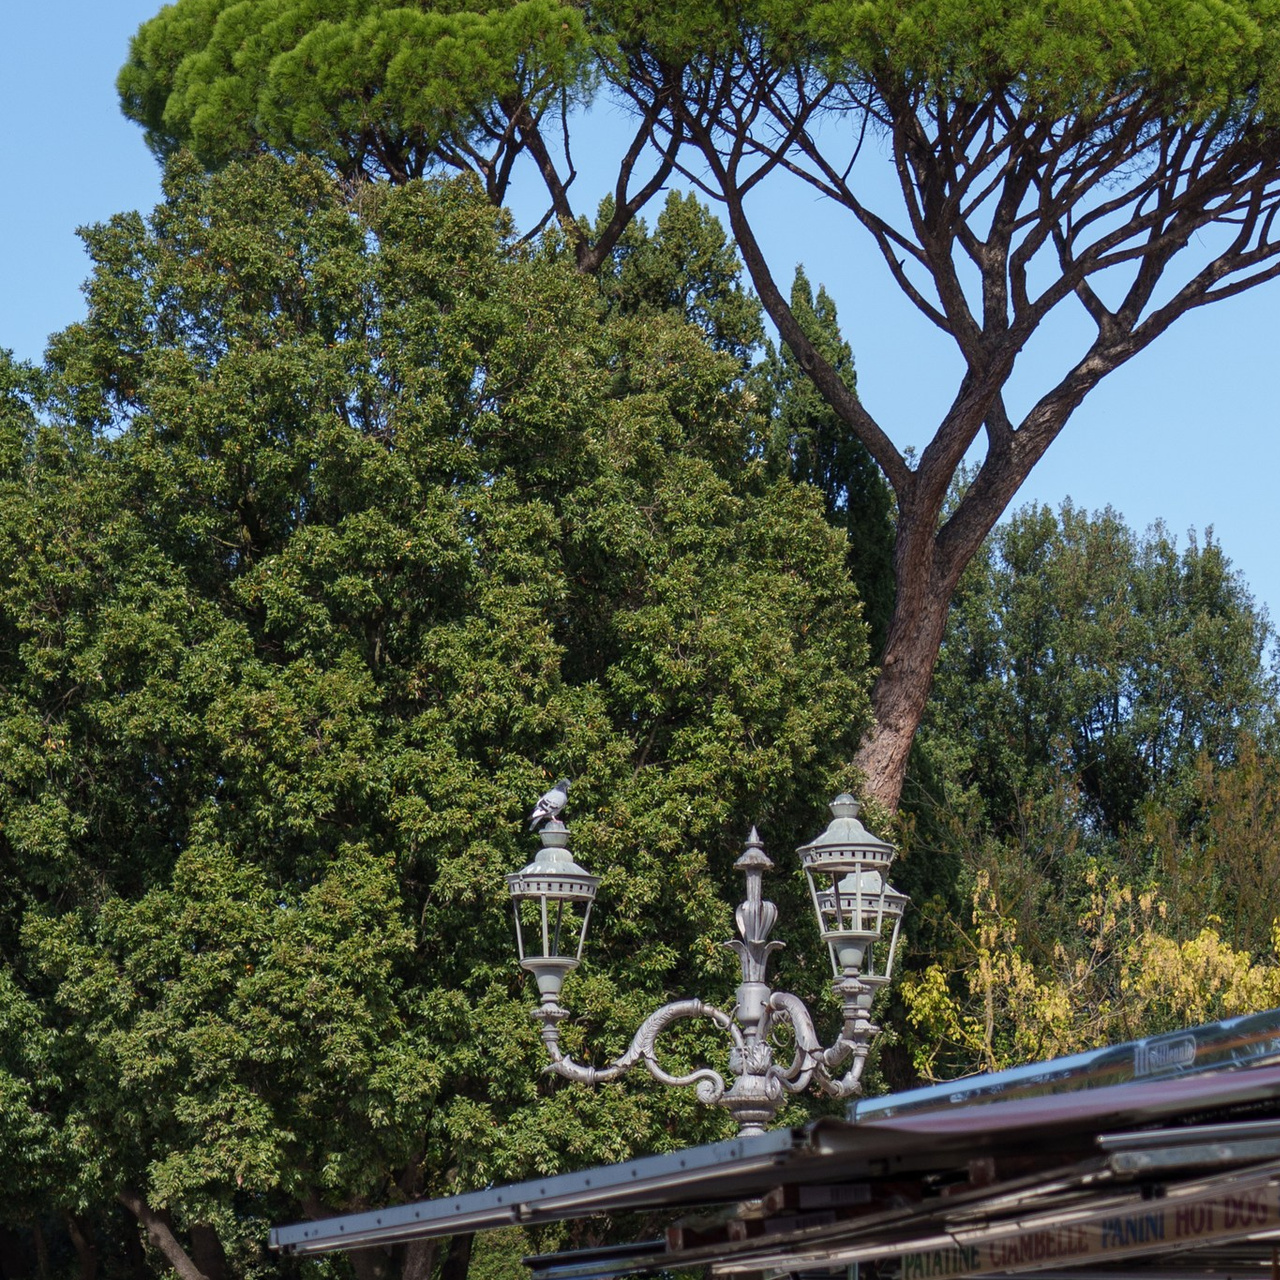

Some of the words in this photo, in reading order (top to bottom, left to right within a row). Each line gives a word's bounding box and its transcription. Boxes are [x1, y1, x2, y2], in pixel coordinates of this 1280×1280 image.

[905, 1244, 981, 1280] PATATINE
[990, 1222, 1089, 1268] CIAMBELLE
[1101, 1209, 1165, 1249] PANINI
[1175, 1199, 1217, 1237] HOT
[1224, 1189, 1269, 1230] DOG
